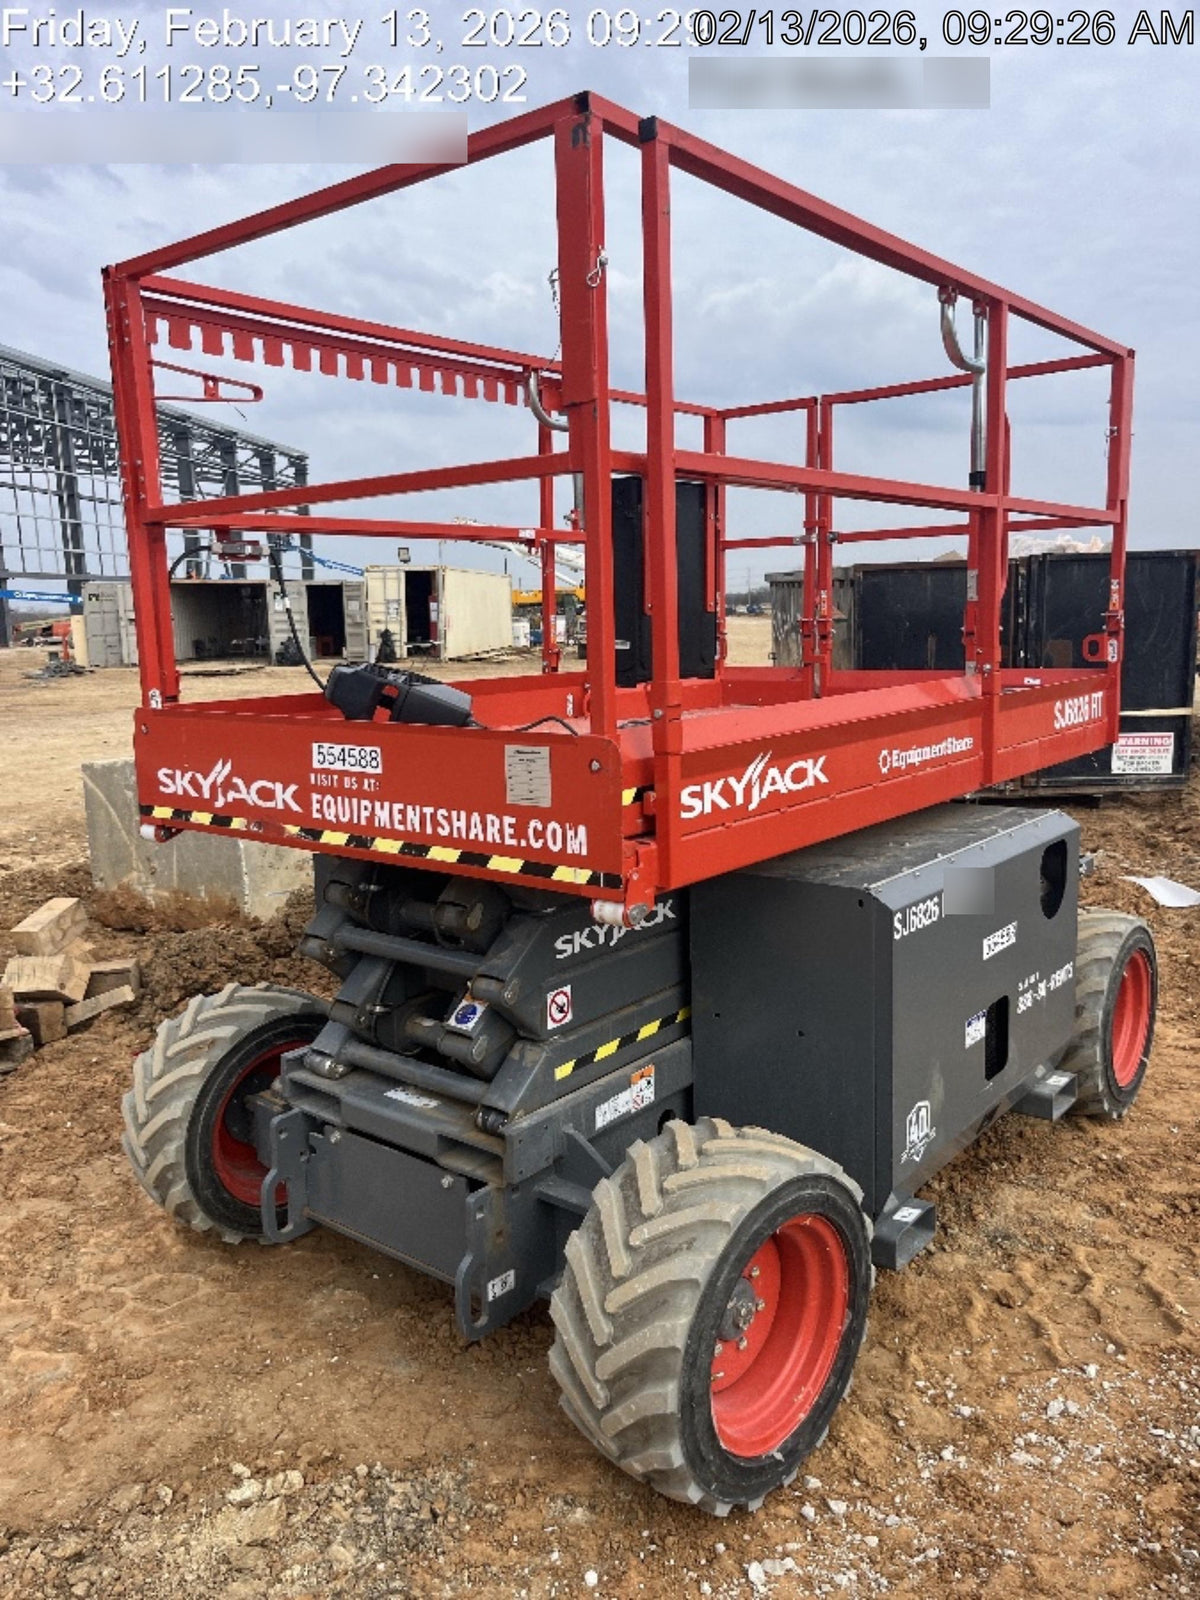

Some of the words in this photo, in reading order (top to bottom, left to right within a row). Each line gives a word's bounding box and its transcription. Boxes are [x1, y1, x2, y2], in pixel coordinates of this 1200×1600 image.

[317, 744, 379, 769] 554588
[892, 736, 974, 770] EquipmentShare
[156, 757, 304, 814] SKYJACK
[310, 772, 339, 788] VISIT
[344, 776, 358, 790] US
[680, 749, 830, 820] SKYJACK
[311, 792, 588, 857] EQUIPMENTSHARE.COM
[893, 895, 940, 940] SJ6826
